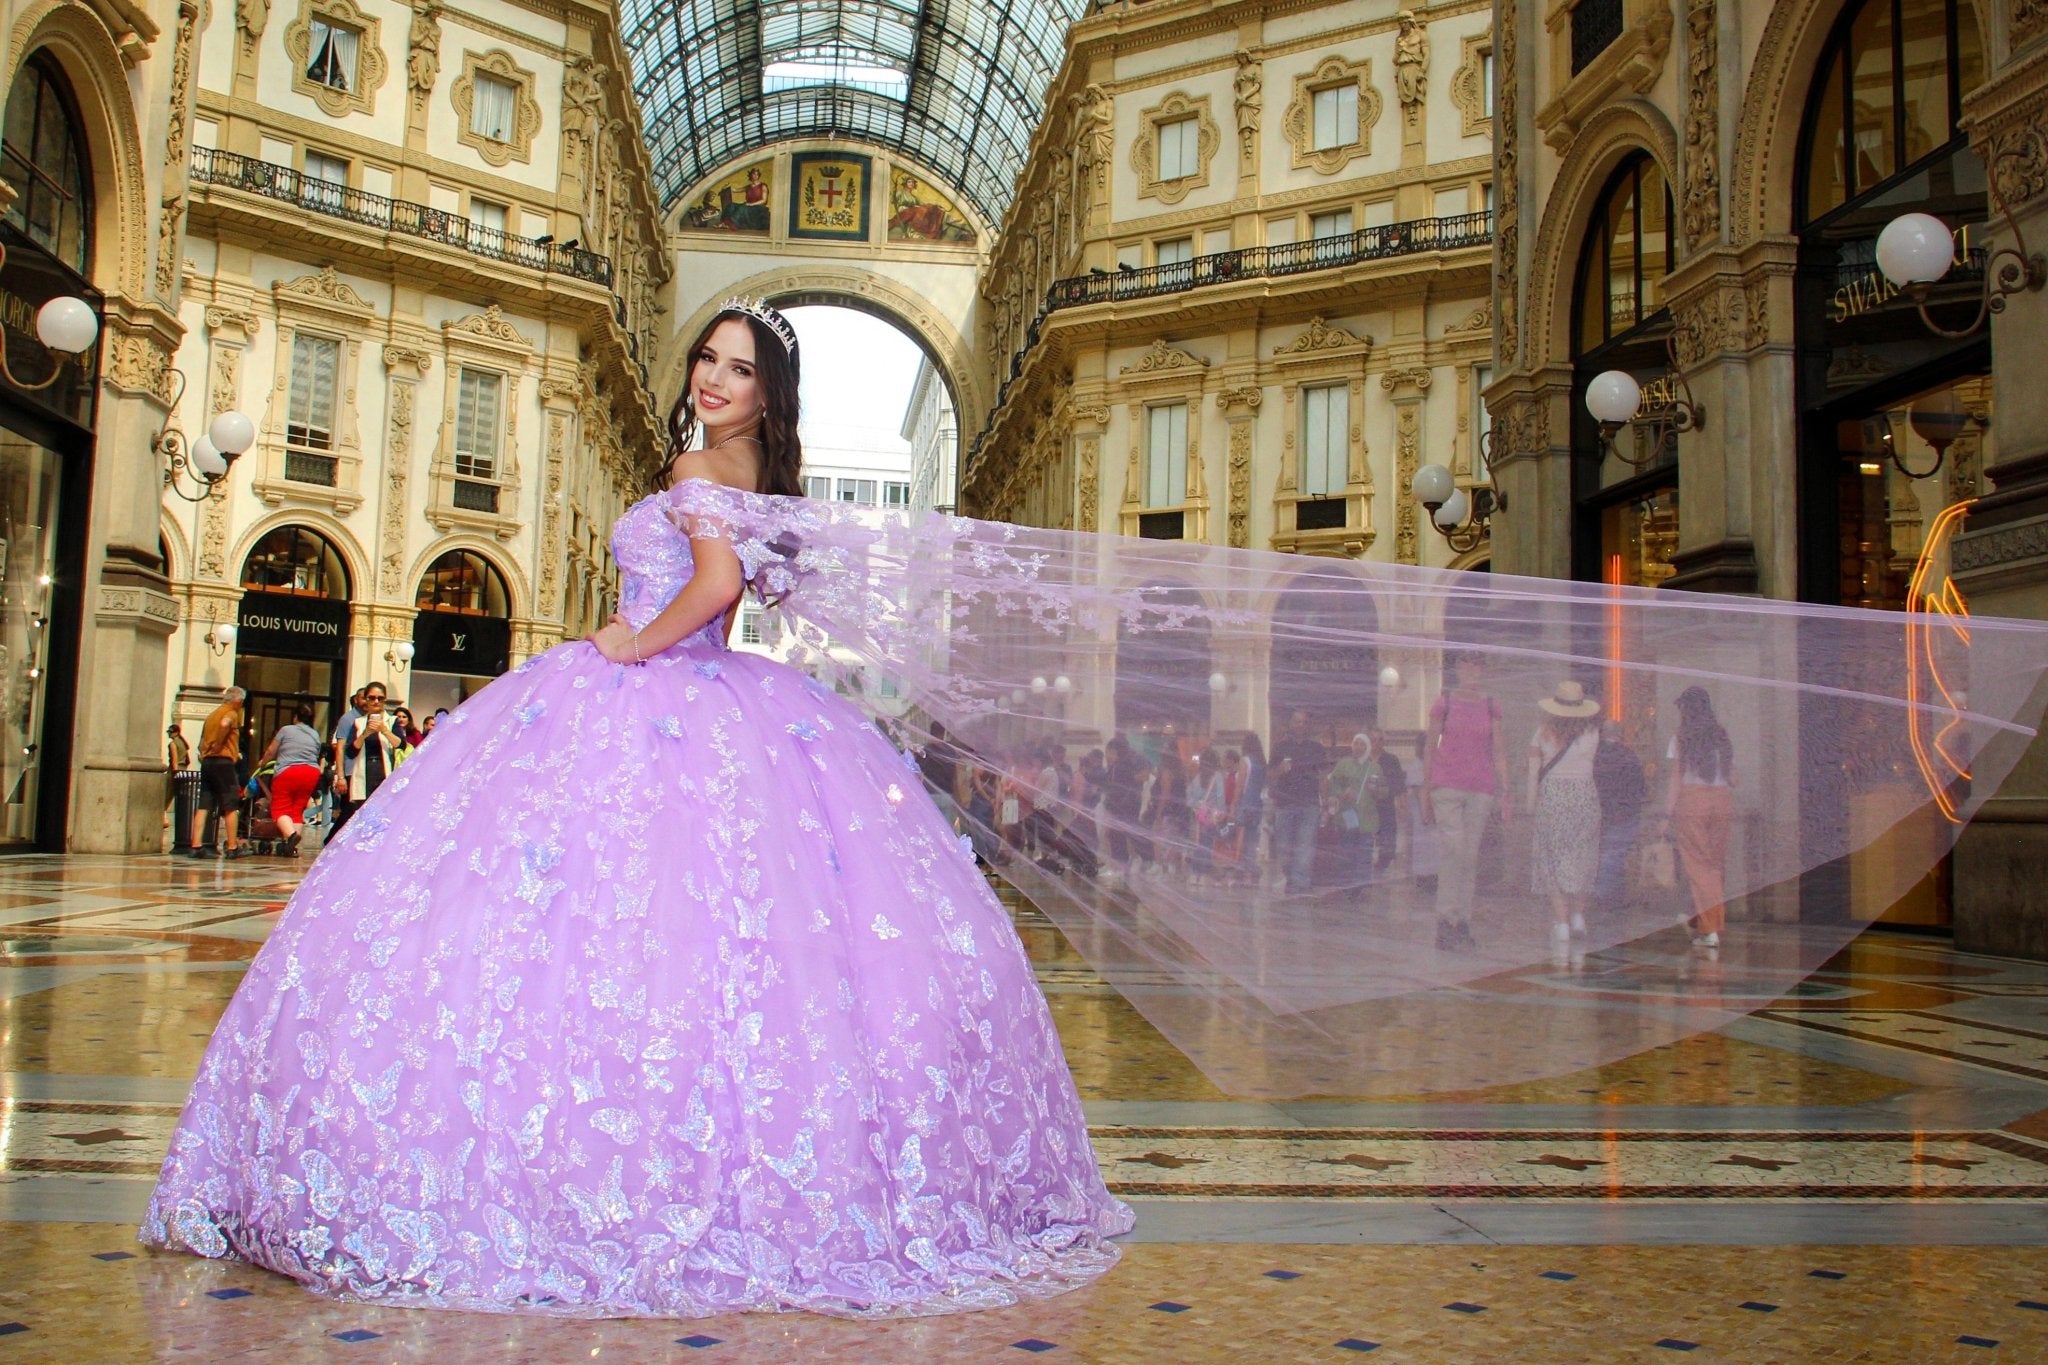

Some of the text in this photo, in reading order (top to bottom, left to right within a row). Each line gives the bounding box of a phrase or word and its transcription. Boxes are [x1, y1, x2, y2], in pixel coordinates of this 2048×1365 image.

[0, 286, 41, 341] IORGI
[243, 614, 338, 636] LOUIS VUITTON
